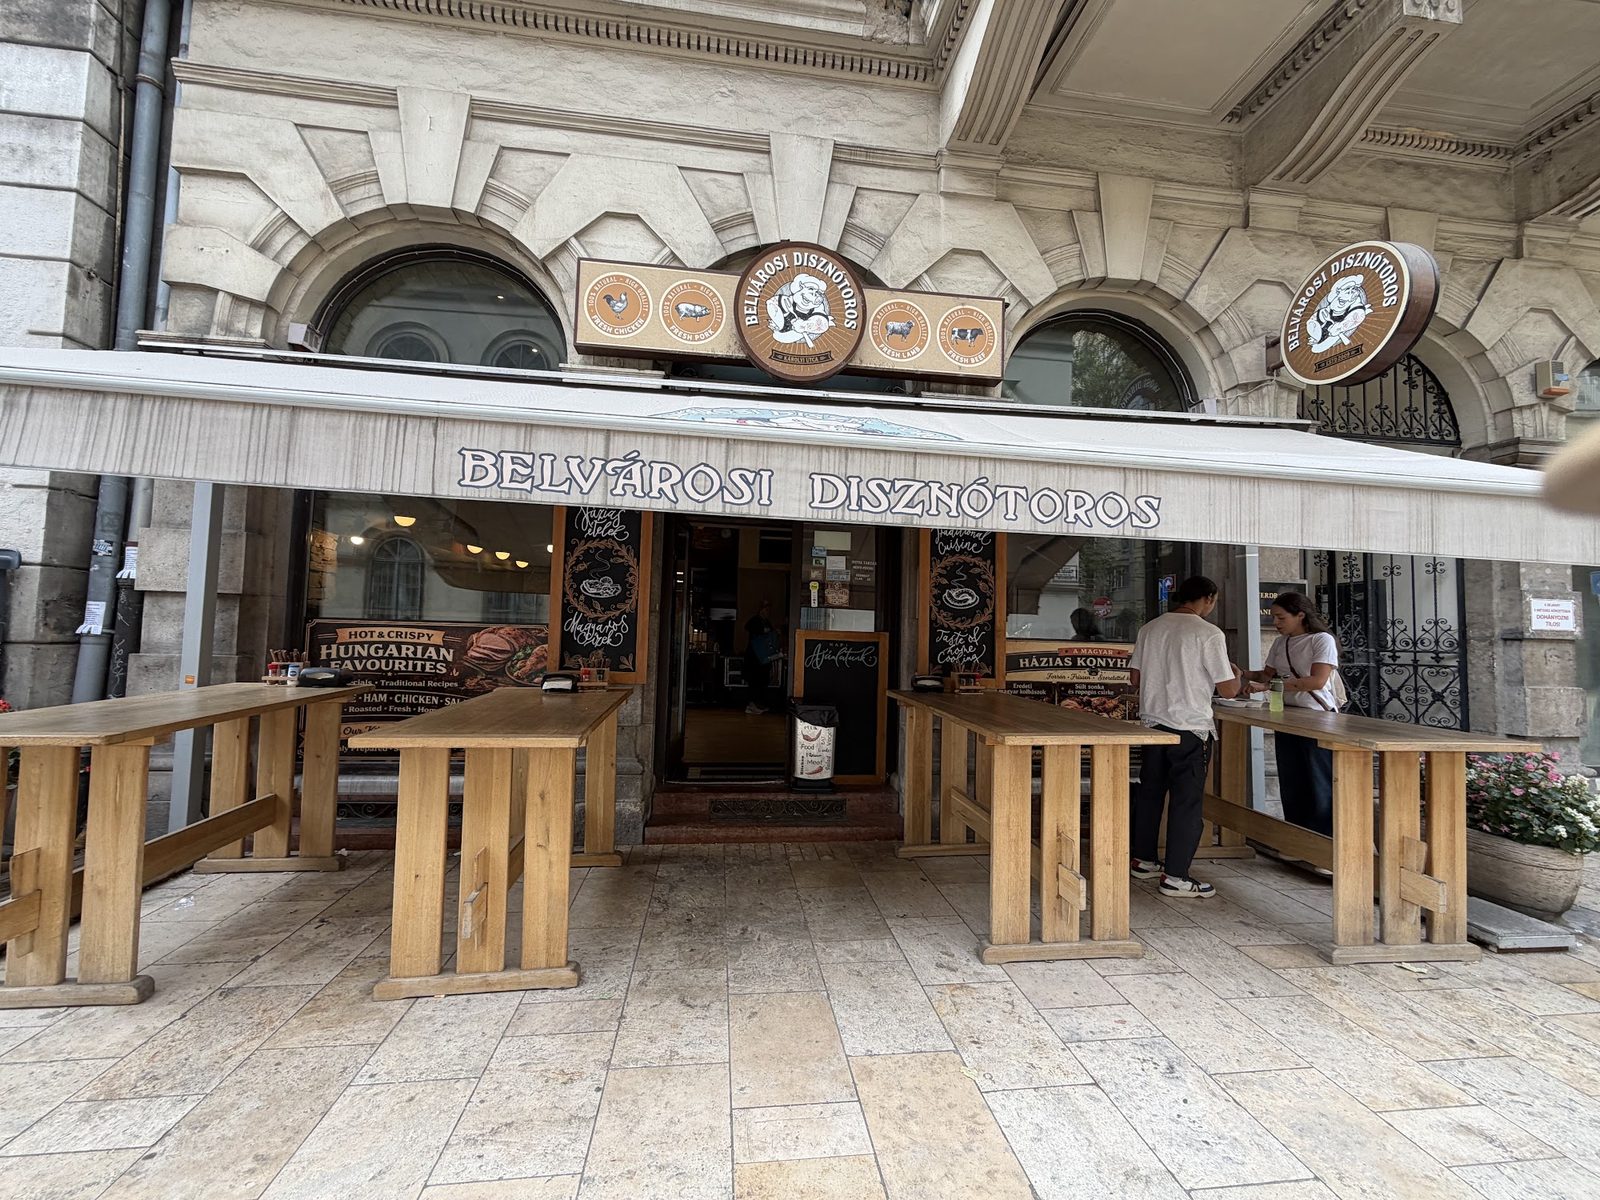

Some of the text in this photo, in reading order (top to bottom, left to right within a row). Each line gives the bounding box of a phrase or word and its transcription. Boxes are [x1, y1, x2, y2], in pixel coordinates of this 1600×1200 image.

[595, 276, 617, 291] NATURAL
[625, 278, 638, 289] HIGH
[637, 286, 649, 312] QUALITY
[744, 251, 858, 330] BELVÁROSI DISZNÓTOROS
[669, 284, 691, 300] NATURAL
[700, 285, 714, 298] HIGH
[712, 293, 722, 322] QUALITY
[1287, 252, 1399, 352] BELVÁROSI DISZNÓTOROS
[591, 315, 645, 335] FRESH CHICKEN
[877, 304, 898, 319] NATURAL
[906, 305, 919, 317] HIGH
[918, 315, 928, 340] QUALITY
[944, 310, 965, 326] NATURAL
[973, 311, 985, 322] HIGH
[984, 320, 994, 346] QUALITY
[669, 326, 715, 341] FRESH PORK
[879, 344, 921, 359] FRESH LAMB
[947, 350, 987, 365] FRESH BEEF
[457, 447, 1162, 529] BELVÁROSI DISZNÓTOROS
[348, 630, 434, 642] HOT & CRISPY
[936, 629, 969, 646] Taste
[968, 626, 986, 646] of
[320, 643, 454, 662] HUNGARIAN
[1081, 648, 1114, 656] MAGYAR
[330, 658, 447, 674] FAVOURITES
[1019, 655, 1073, 668] HÁZIAS
[380, 680, 426, 688] Traditional
[427, 680, 459, 689] Recipes
[363, 693, 388, 703] HAM
[394, 694, 440, 705] CHICKEN
[348, 705, 382, 713] Roasted
[388, 705, 412, 713] Fresh
